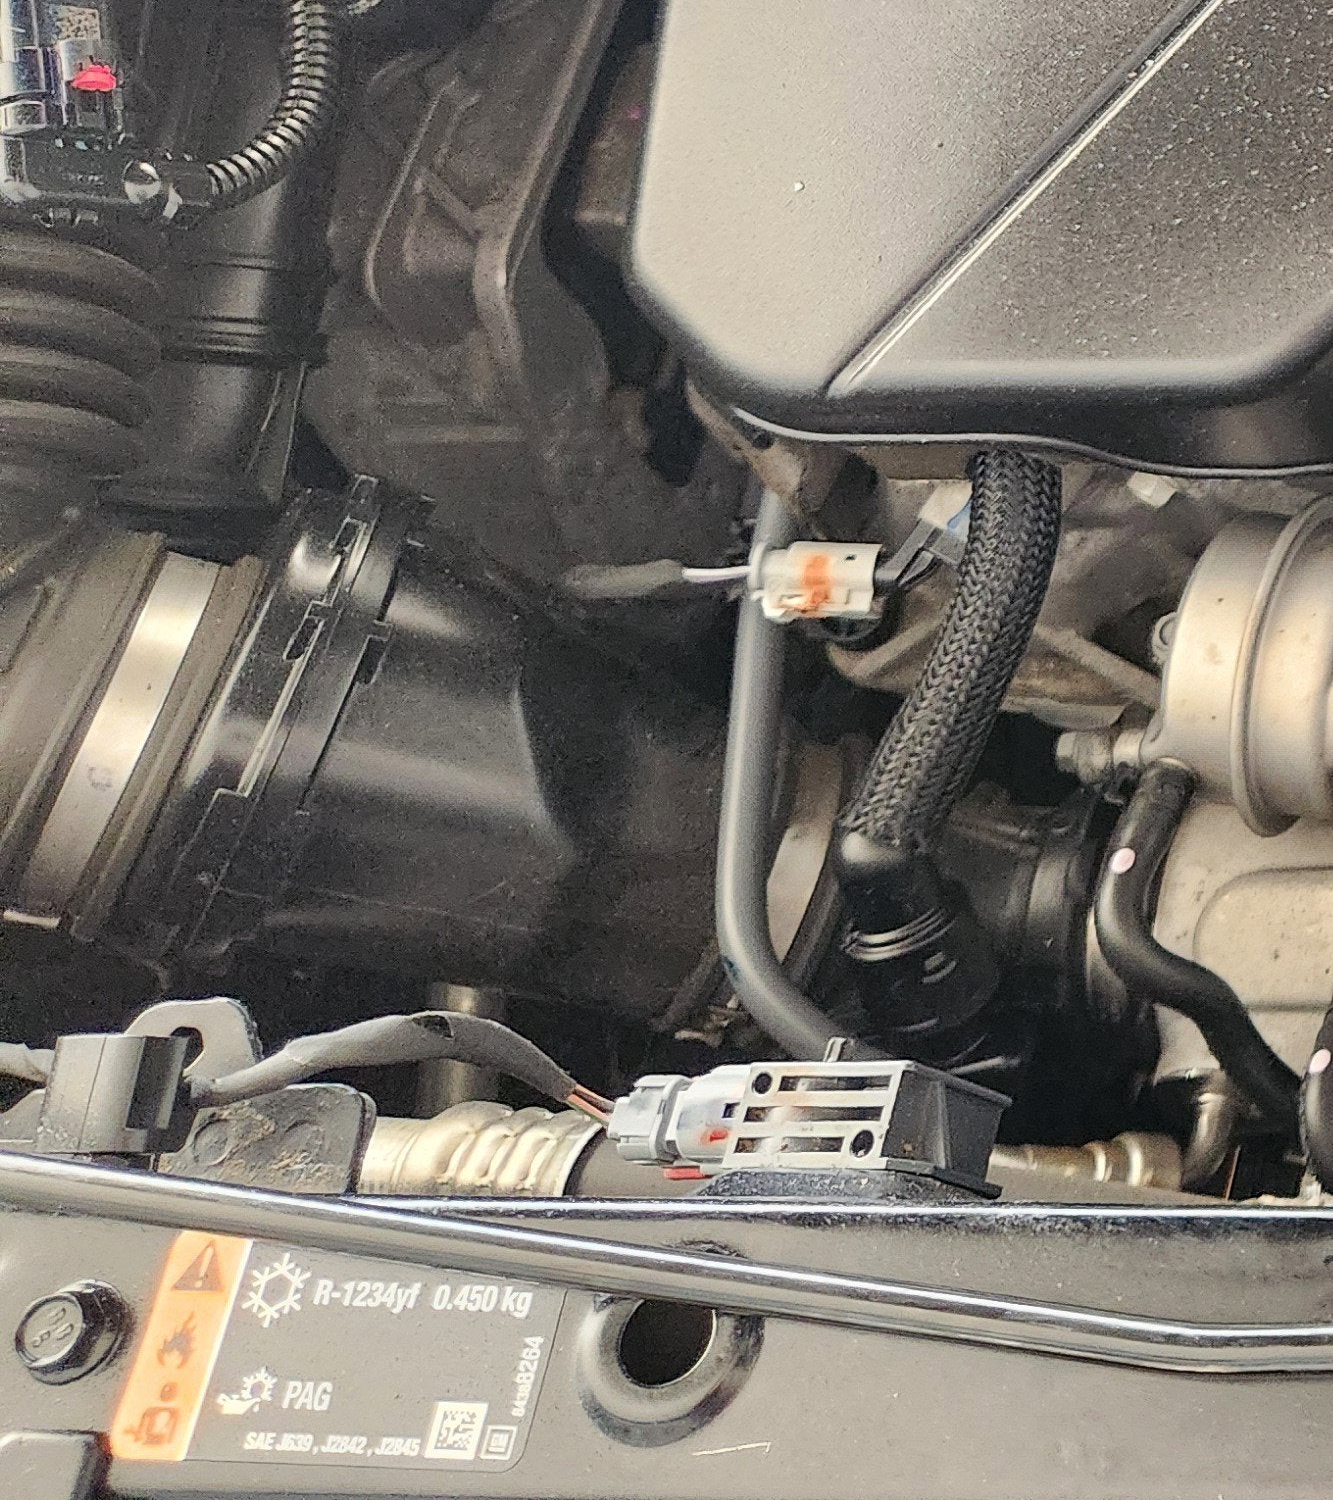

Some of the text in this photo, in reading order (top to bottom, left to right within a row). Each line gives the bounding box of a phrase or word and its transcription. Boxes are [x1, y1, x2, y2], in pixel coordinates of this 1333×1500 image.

[313, 1279, 534, 1320] R-1234yf 0.450 kg
[281, 1380, 334, 1411] PAG
[243, 1431, 277, 1451] SAE
